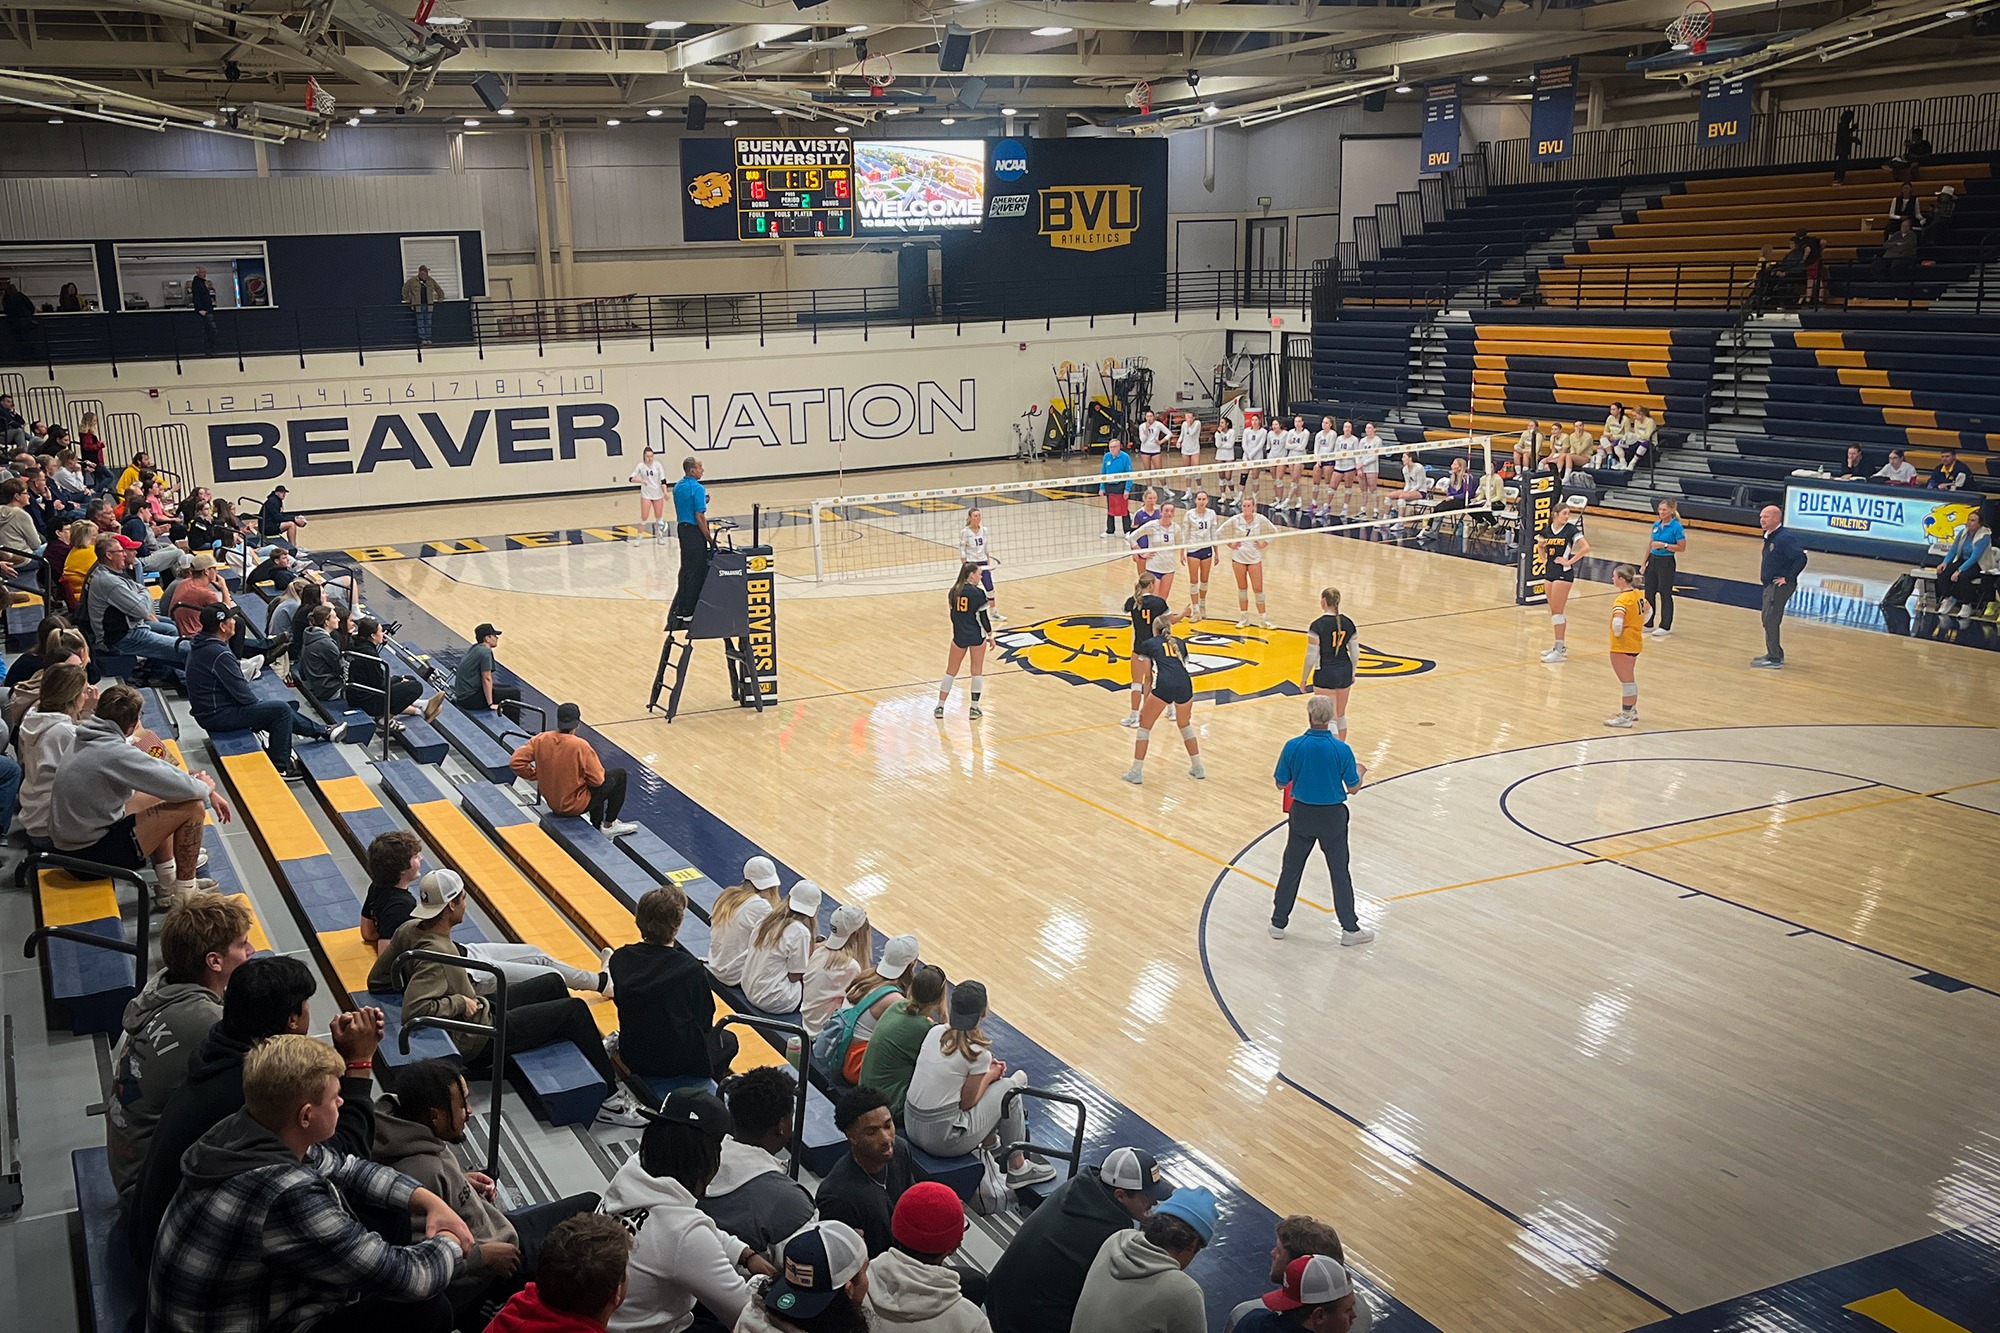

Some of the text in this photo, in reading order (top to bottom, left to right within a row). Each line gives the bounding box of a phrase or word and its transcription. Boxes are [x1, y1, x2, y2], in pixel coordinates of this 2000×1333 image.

[1708, 120, 1737, 138] BVU
[738, 140, 849, 152] BUENA VISTA
[1538, 140, 1563, 154] BVU
[742, 153, 846, 166] UNIVERSITY
[995, 159, 1026, 171] NCAA
[1428, 152, 1450, 166] BVU
[751, 181, 766, 200] 16
[835, 181, 849, 198] 15
[801, 194, 810, 208] 2
[857, 200, 983, 218] WELCOME
[1042, 190, 1139, 231] BVU
[861, 217, 982, 227] TO BUENA VISTA UNIVERSITY
[1061, 233, 1120, 244] ATHLETICS
[185, 400, 193, 411] 1
[221, 396, 234, 409] 2
[261, 394, 274, 409] 3
[318, 388, 326, 401] 4
[363, 388, 372, 402] 5
[406, 383, 414, 397] 6
[450, 382, 459, 395] 7
[496, 380, 504, 393] 8
[574, 376, 594, 391] 10
[208, 379, 976, 483] BEAVER NATION
[1799, 492, 1905, 523] BUENA VISTA
[1830, 517, 1868, 530] ATHLETICS
[1164, 534, 1169, 542] 9
[956, 596, 968, 612] 19
[1142, 609, 1150, 624] 4
[747, 579, 773, 671] BEAVERS
[1332, 631, 1346, 647] 17
